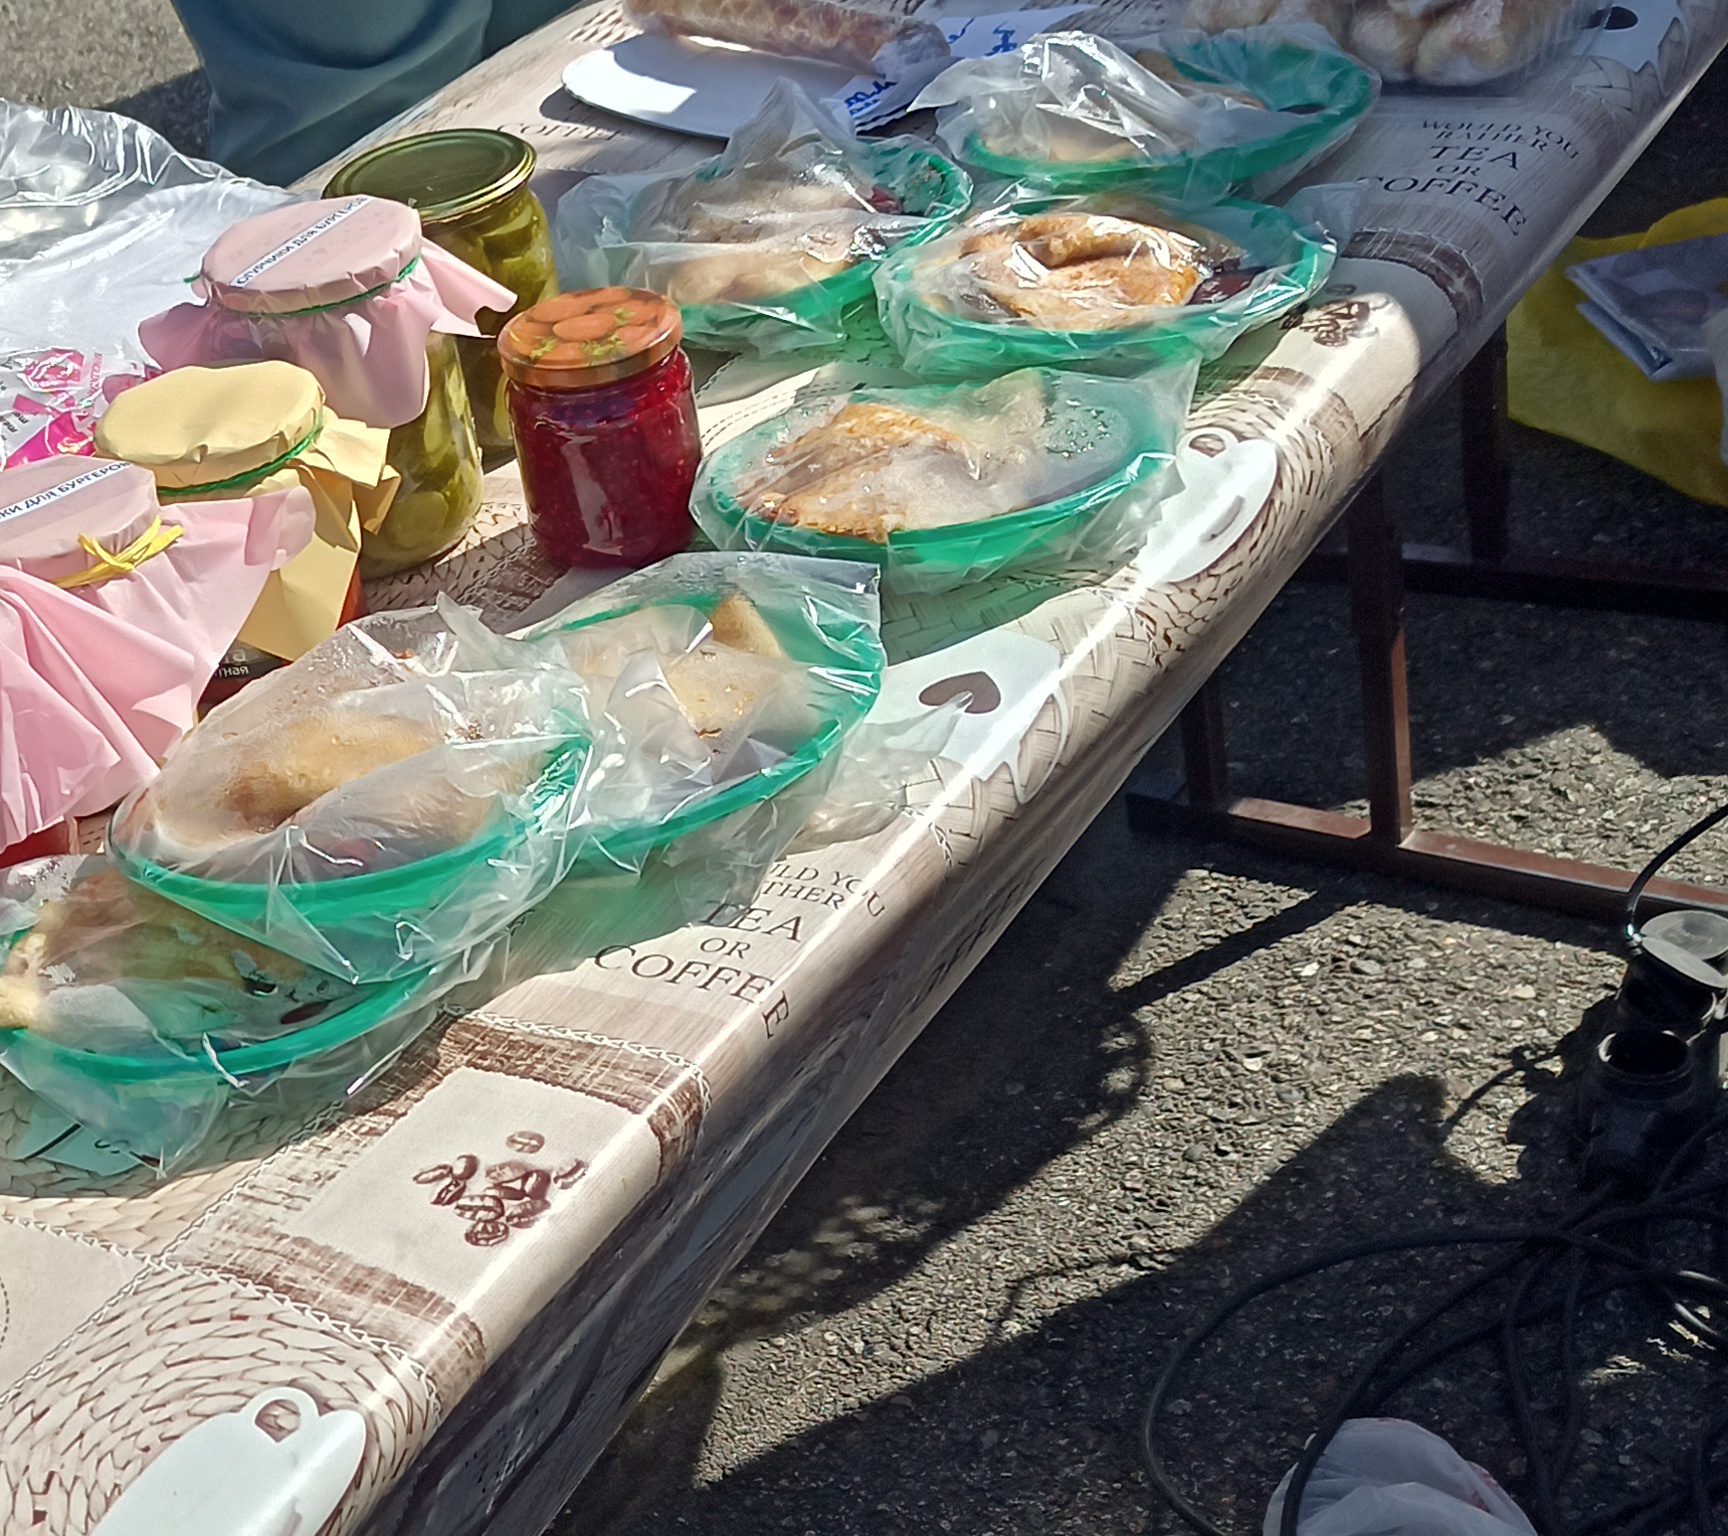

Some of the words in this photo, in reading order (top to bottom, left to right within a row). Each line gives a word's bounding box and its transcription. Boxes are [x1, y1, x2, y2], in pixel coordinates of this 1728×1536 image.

[1435, 130, 1548, 152] RATHER
[1533, 125, 1580, 159] YOU
[1429, 145, 1519, 171] TEA
[1435, 165, 1481, 177] OR
[24, 491, 57, 508] ДЛЯ
[761, 880, 846, 910] THER
[699, 900, 802, 942] TEA
[699, 937, 752, 959] OR
[593, 944, 790, 1040] COFFEE
